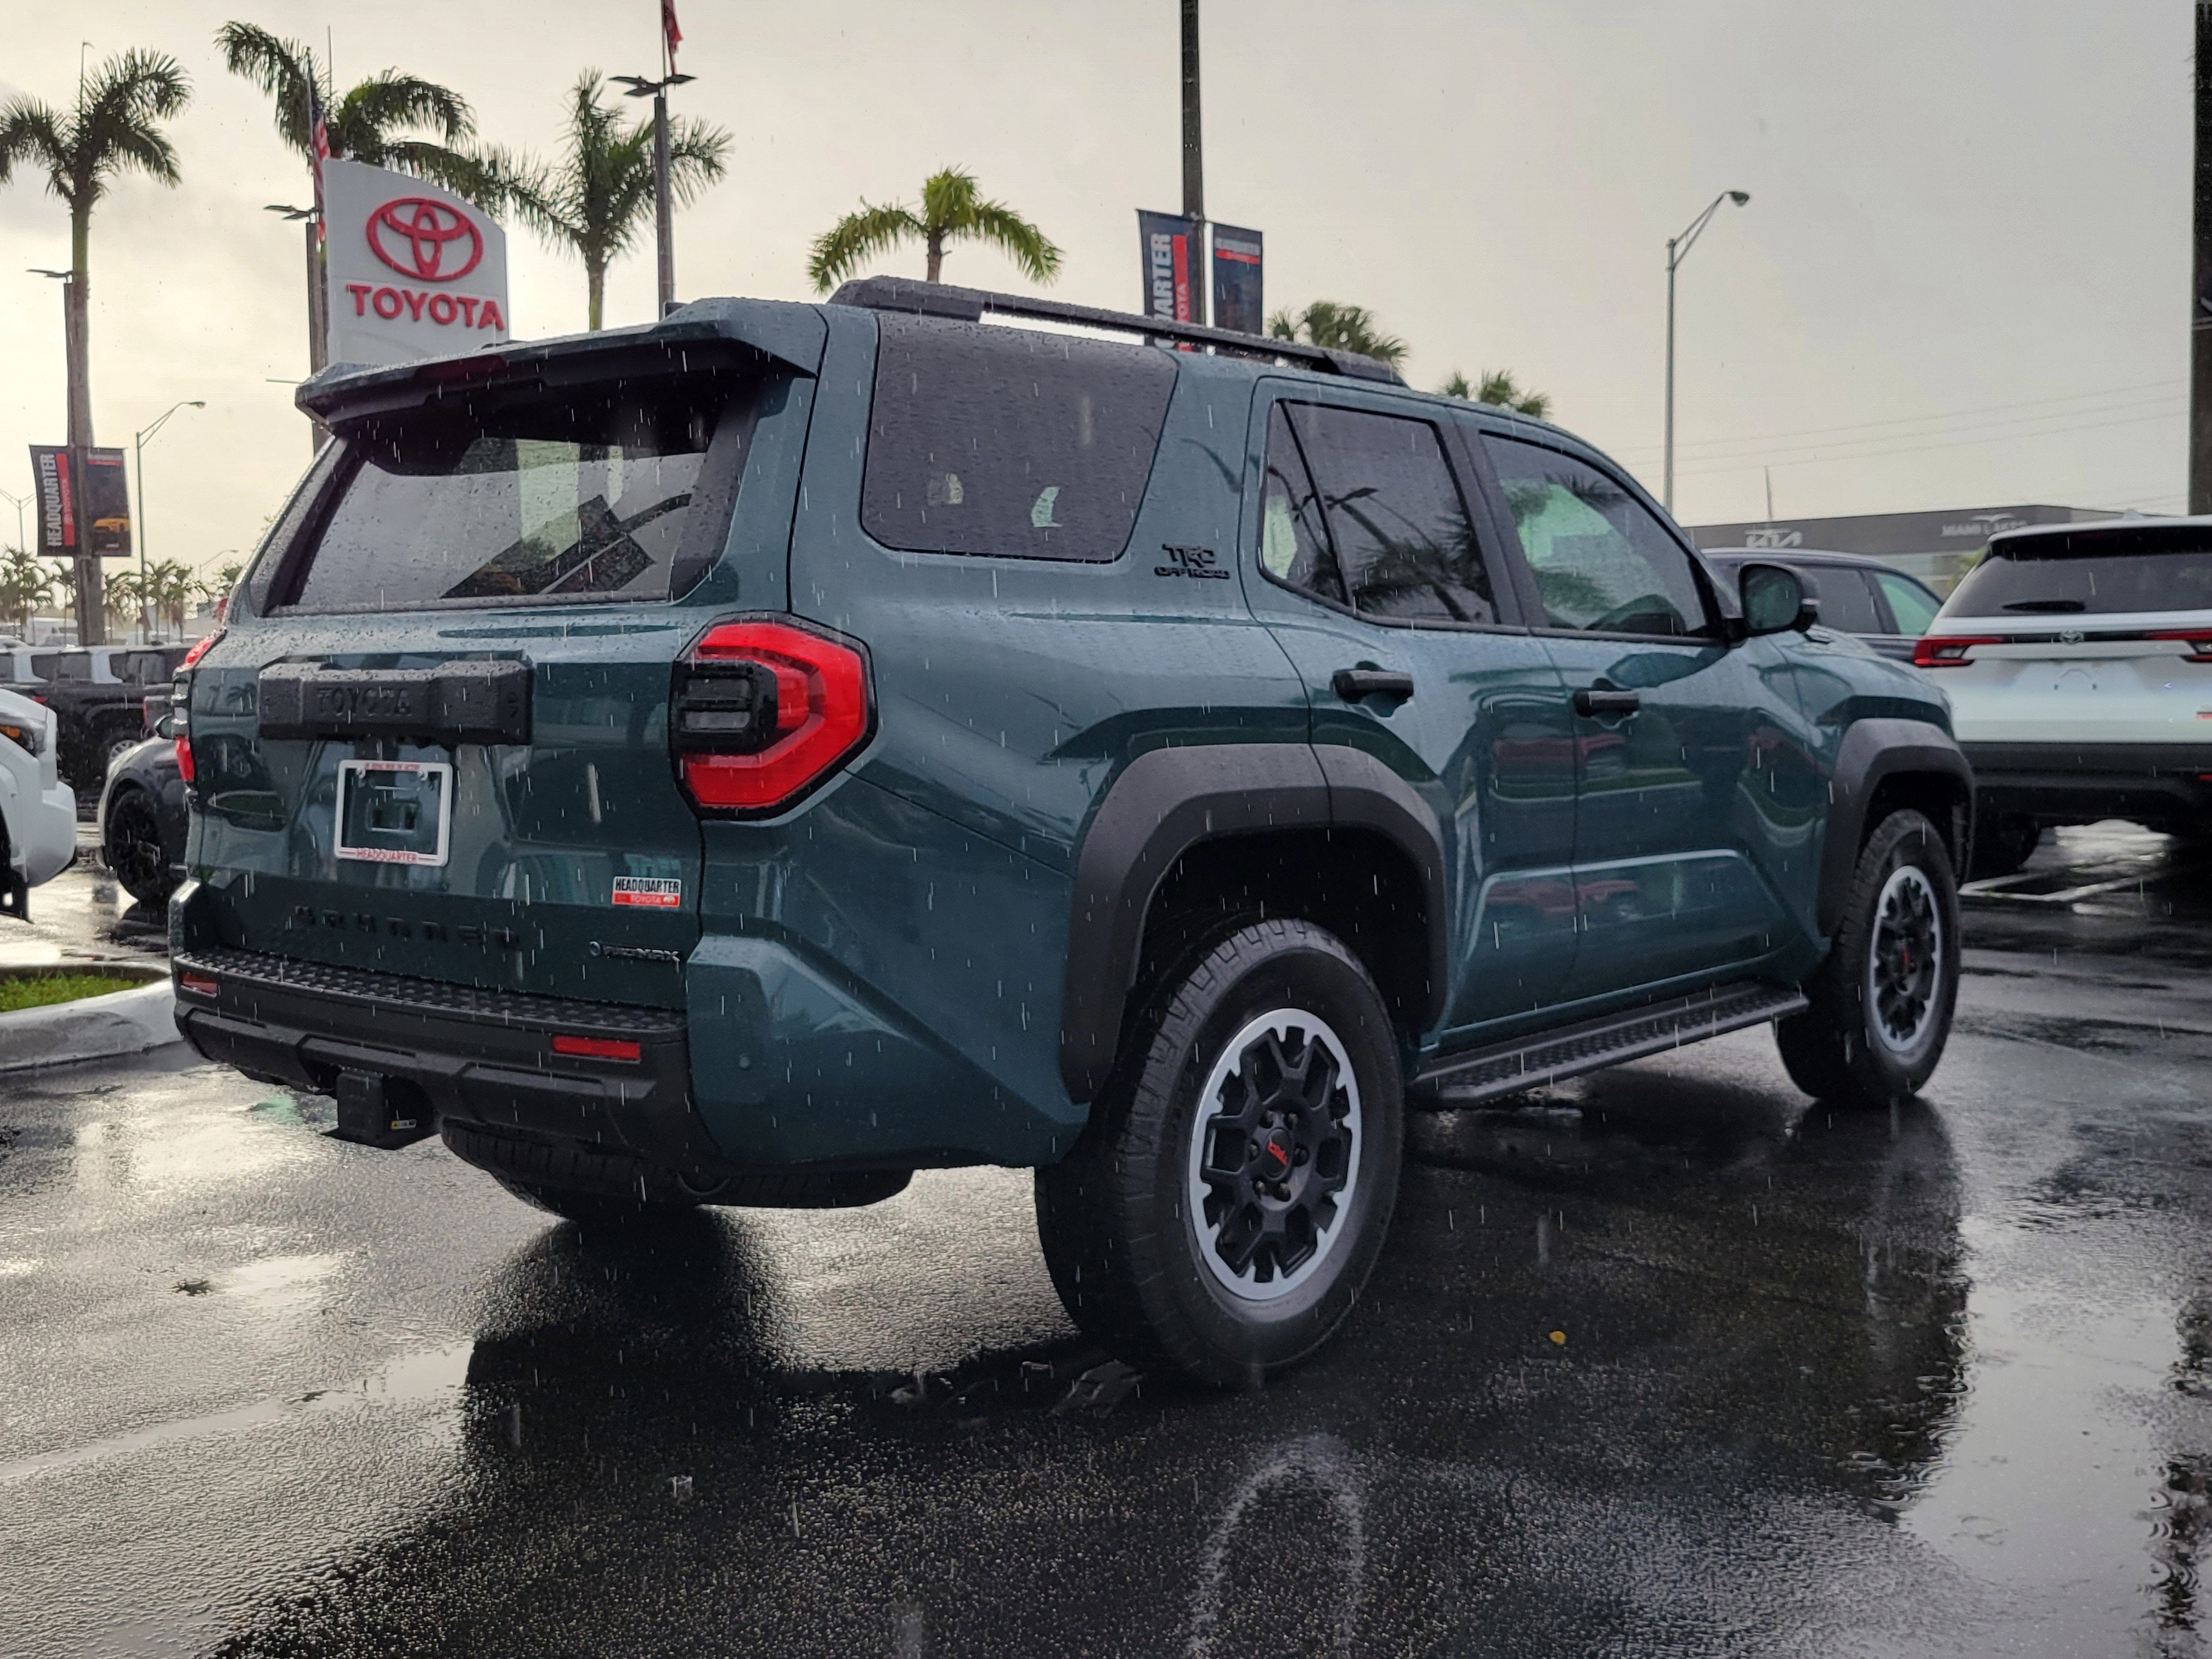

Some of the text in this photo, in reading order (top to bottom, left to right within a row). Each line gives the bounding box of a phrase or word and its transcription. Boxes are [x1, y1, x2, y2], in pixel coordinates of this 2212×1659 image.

[347, 284, 505, 331] TOYOTA
[40, 454, 63, 546] HEADQUARTER
[317, 687, 412, 716] TOYOTA
[357, 848, 418, 863] HEADQUARTER
[616, 878, 680, 894] HEADQUARTER
[630, 894, 662, 904] TOYOTA
